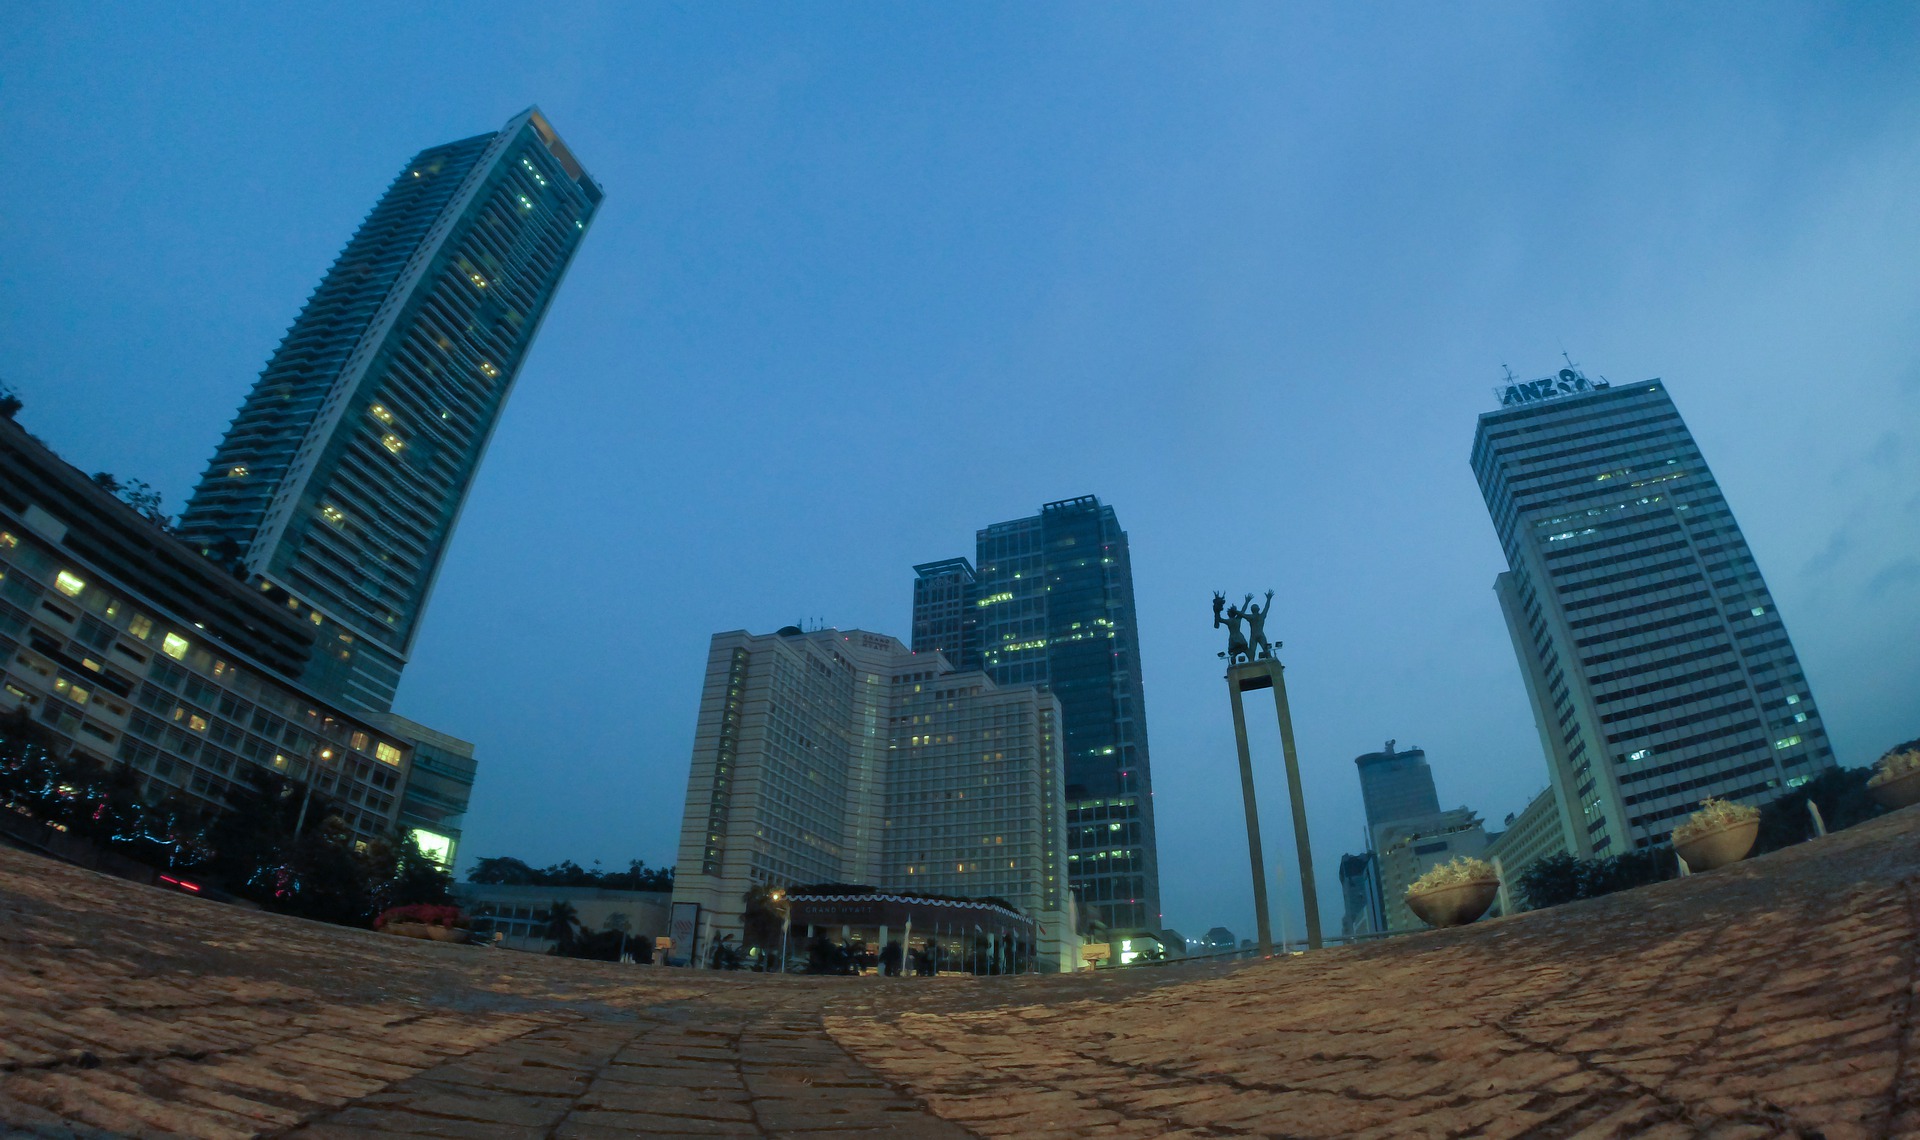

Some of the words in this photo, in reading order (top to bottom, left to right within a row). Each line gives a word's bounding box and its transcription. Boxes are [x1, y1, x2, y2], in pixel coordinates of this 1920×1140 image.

[1503, 379, 1558, 404] ANZ
[862, 634, 890, 643] GRAND
[862, 643, 889, 651] HYATT
